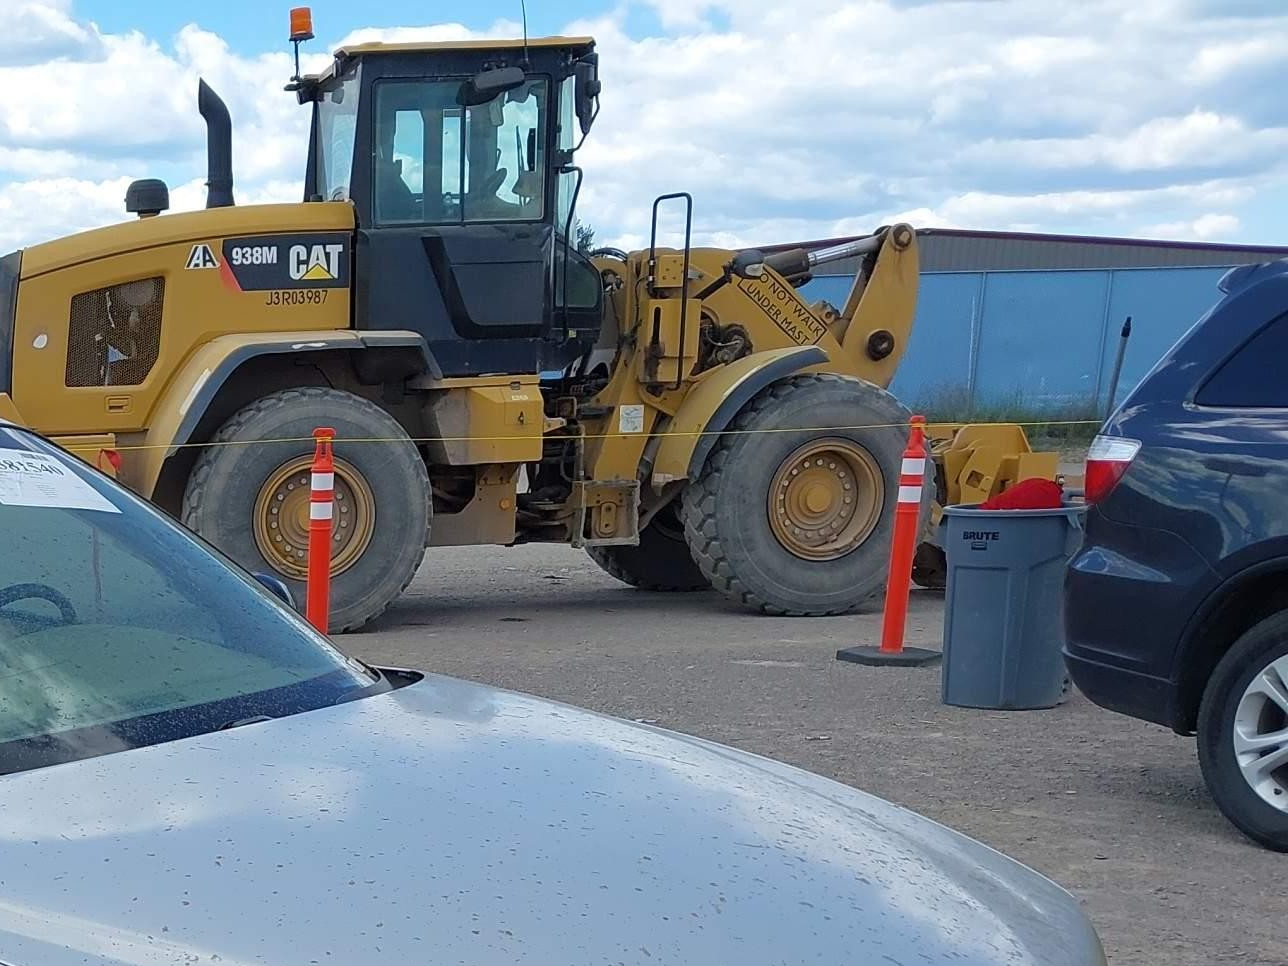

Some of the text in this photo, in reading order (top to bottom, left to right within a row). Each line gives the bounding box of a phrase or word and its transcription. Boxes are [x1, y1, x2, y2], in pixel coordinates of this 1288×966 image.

[231, 244, 344, 281] 938M CAT
[265, 289, 329, 306] J3R03987
[746, 283, 810, 345] UNDER MAST
[768, 282, 794, 307] NOT
[792, 305, 823, 337] WALK
[962, 531, 1000, 541] BRUTE
